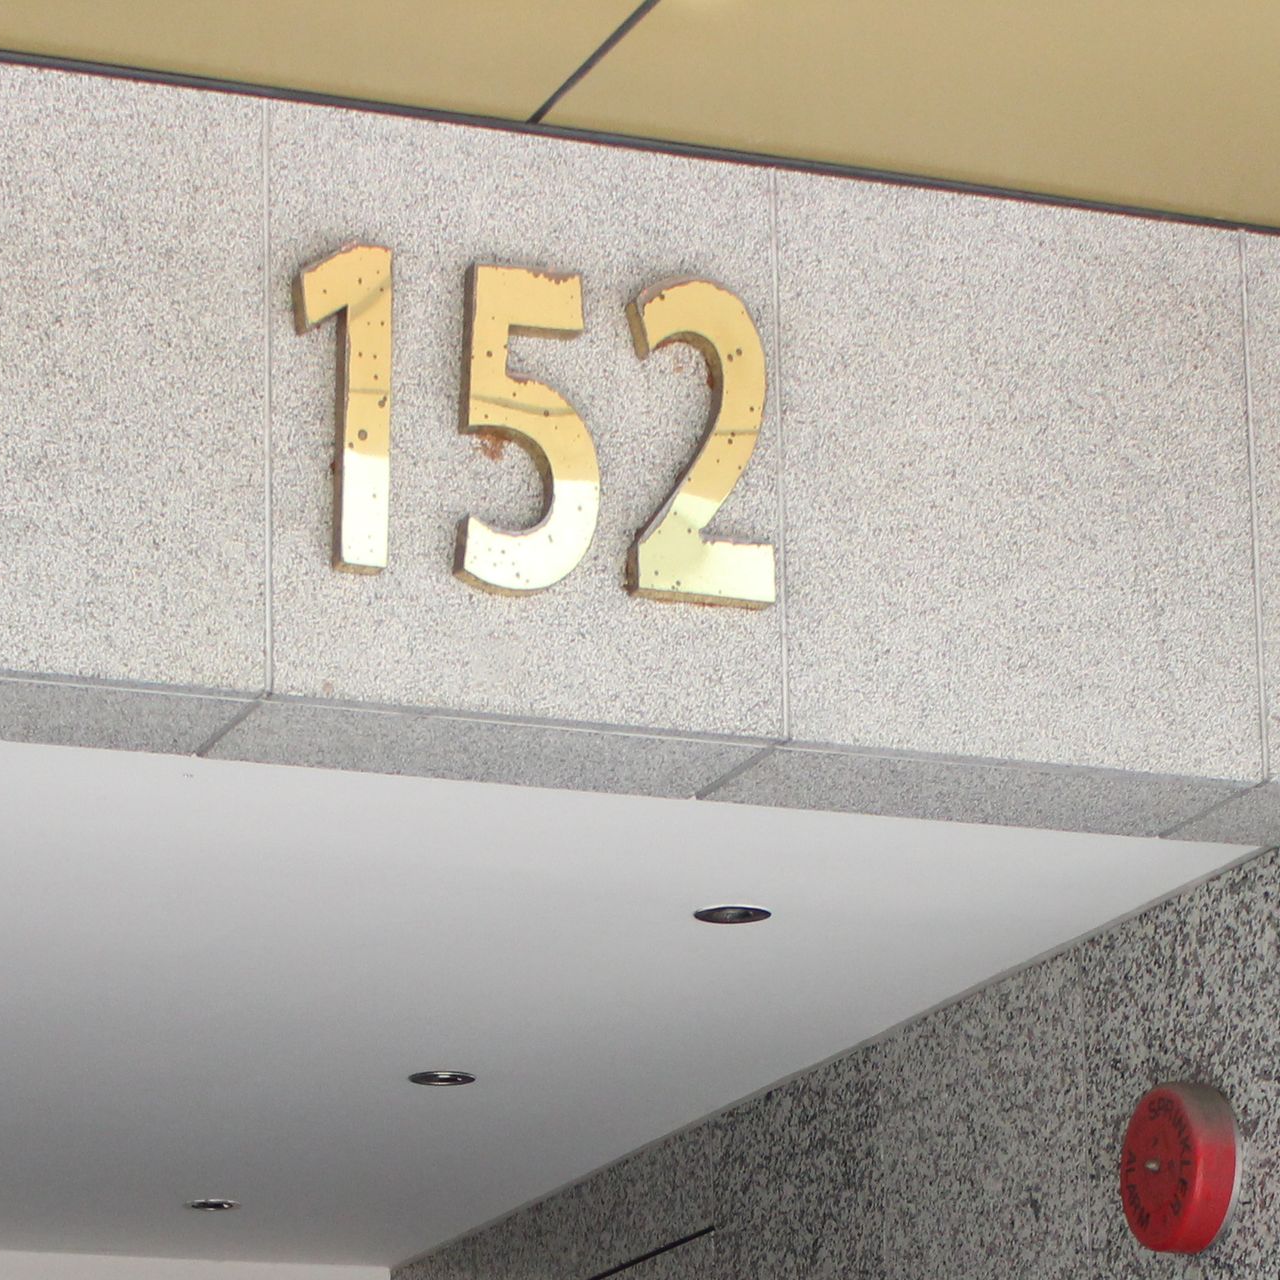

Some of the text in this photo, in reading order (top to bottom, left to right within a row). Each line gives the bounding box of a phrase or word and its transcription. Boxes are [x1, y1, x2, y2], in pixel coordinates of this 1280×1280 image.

[291, 241, 775, 609] 152
[1126, 1150, 1150, 1229] ALARM
[1148, 1097, 1193, 1216] SPRINKLER
